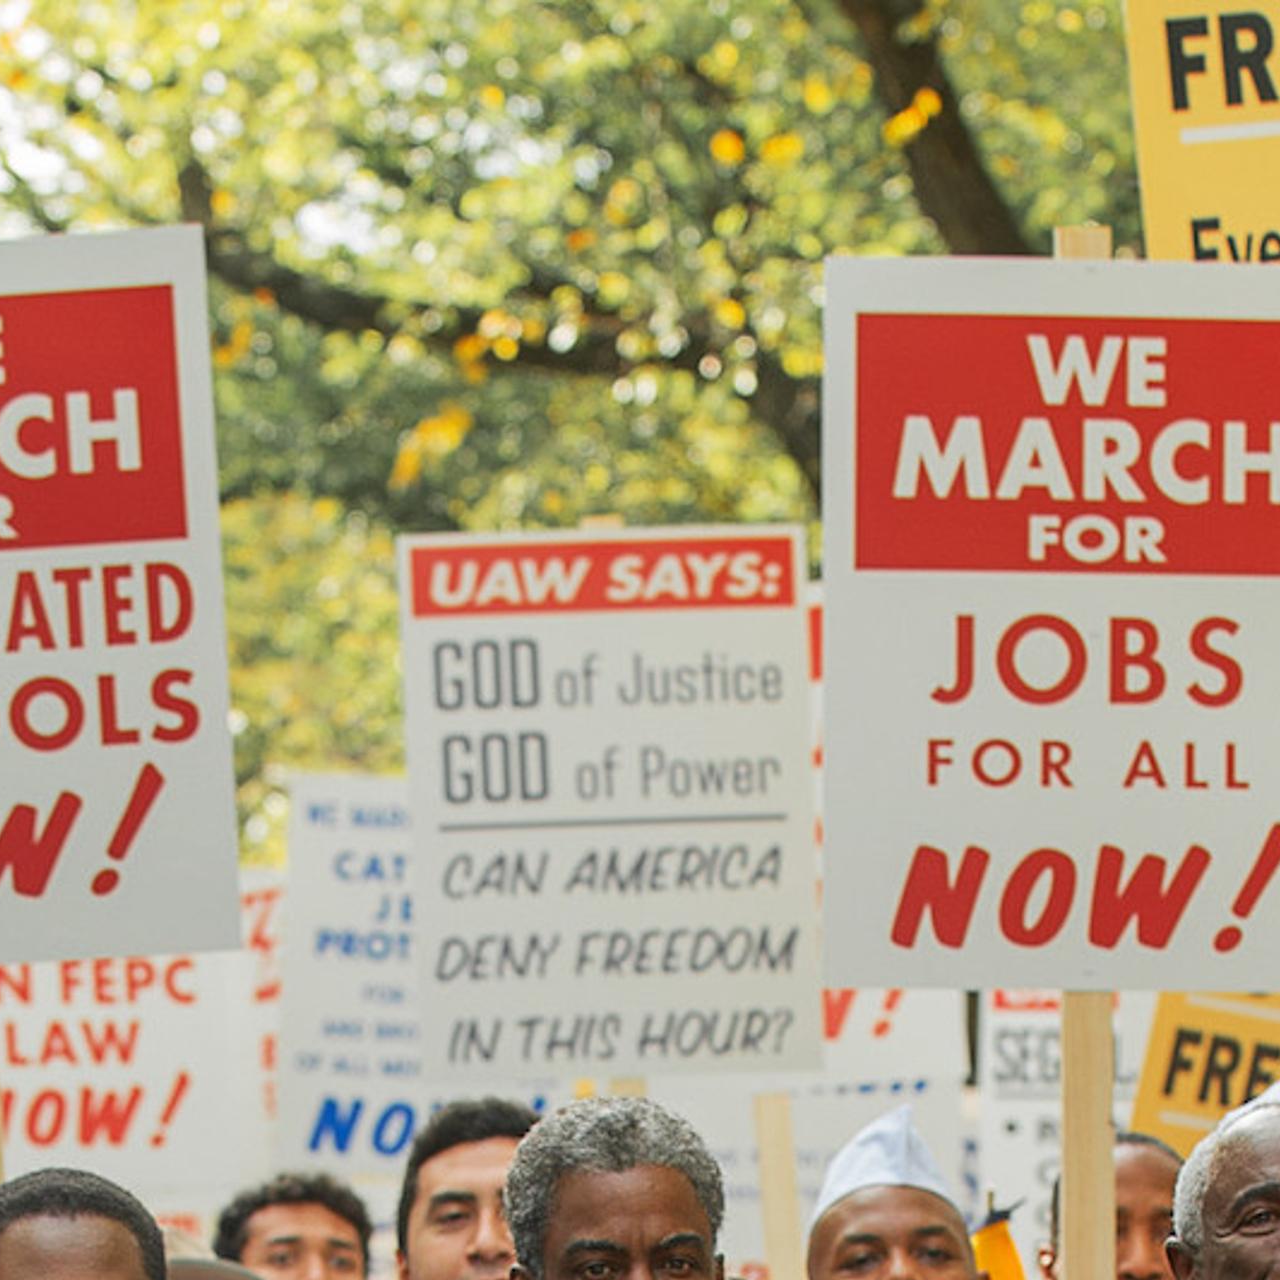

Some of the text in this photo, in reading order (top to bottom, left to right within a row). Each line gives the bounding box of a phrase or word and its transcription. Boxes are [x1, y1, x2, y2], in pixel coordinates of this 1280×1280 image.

[1027, 334, 1167, 408] WE
[1027, 515, 1168, 565] FOR
[428, 552, 782, 607] UAW SAYS:
[431, 637, 784, 711] GOD of Justice
[930, 613, 1244, 708] JOBS
[441, 732, 780, 804] GOD of Power
[926, 738, 1250, 789] FOR ALL
[442, 844, 782, 900] CAN AMERICA
[59, 957, 197, 1005] FEPC
[434, 927, 798, 982] DENY FREEDOM
[4, 1020, 141, 1067] LAW
[447, 1019, 498, 1065] IN
[516, 1014, 620, 1064] THIS
[639, 1008, 794, 1058] HOUR?
